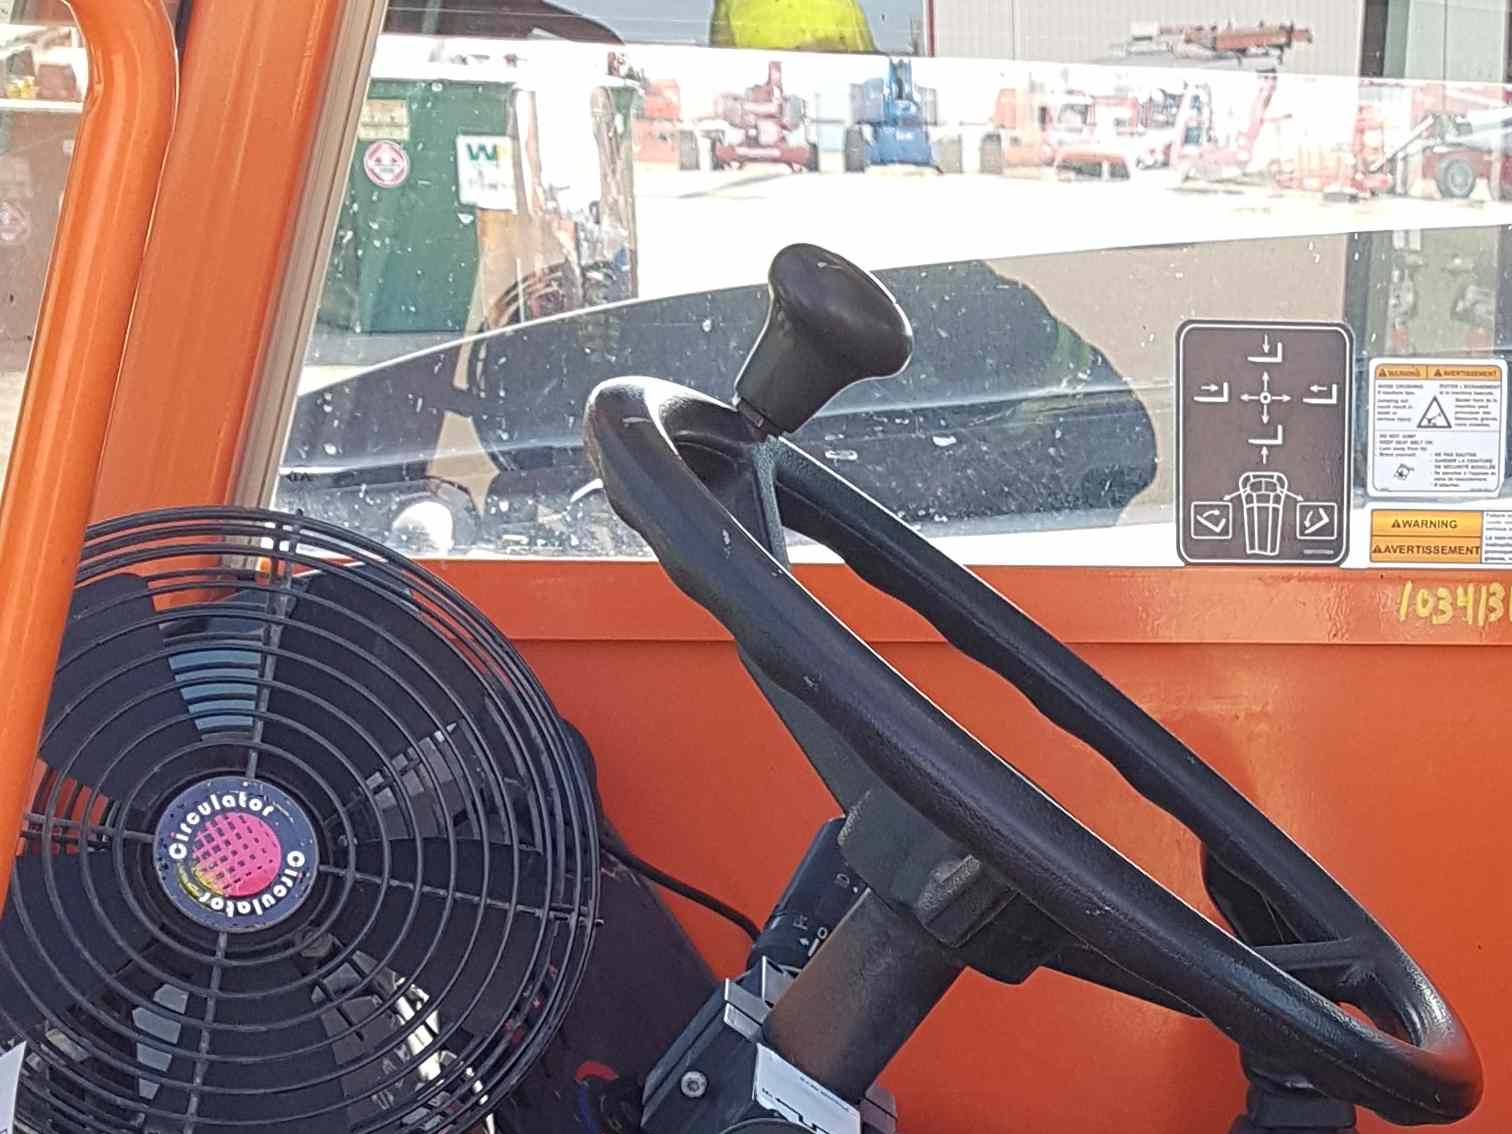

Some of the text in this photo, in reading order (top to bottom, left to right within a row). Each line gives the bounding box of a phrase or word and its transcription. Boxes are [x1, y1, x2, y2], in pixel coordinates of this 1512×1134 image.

[1402, 520, 1458, 529] WARNING
[1383, 545, 1480, 555] AVERTISSEMENT
[168, 791, 274, 860] Circulator
[198, 850, 306, 918] Circulator
